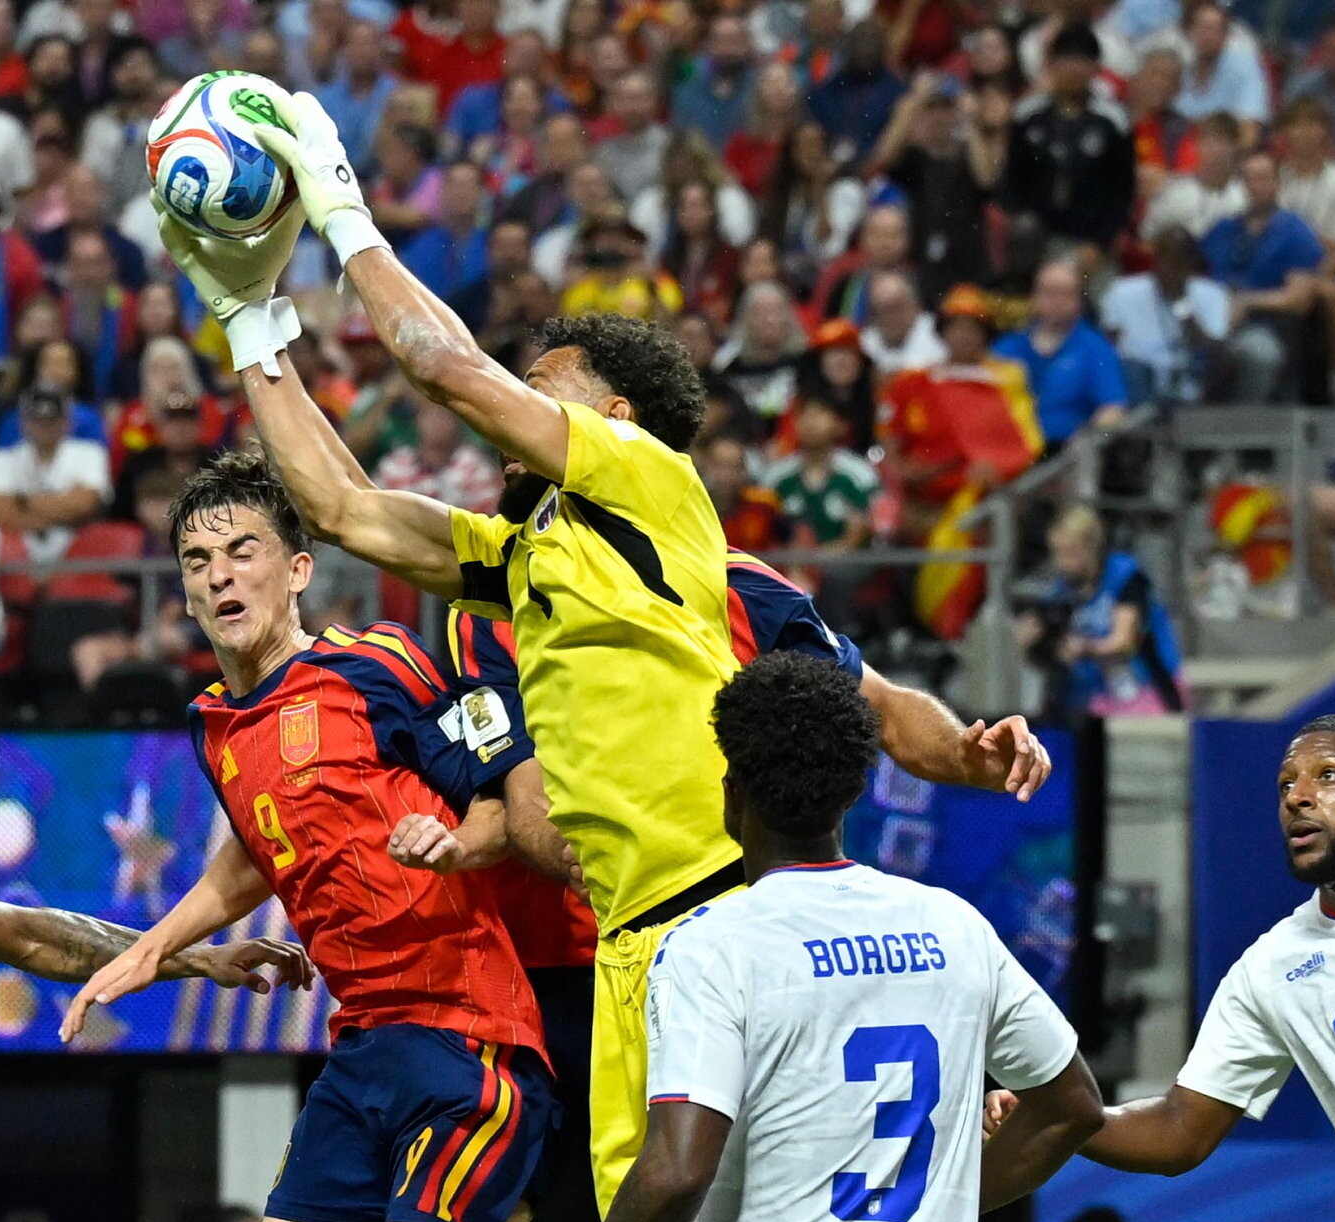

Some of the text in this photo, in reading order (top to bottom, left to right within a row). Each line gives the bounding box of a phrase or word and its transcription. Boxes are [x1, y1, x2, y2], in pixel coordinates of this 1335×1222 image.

[253, 793, 296, 870] 9
[802, 932, 947, 978] BORGES
[396, 1126, 433, 1197] 9
